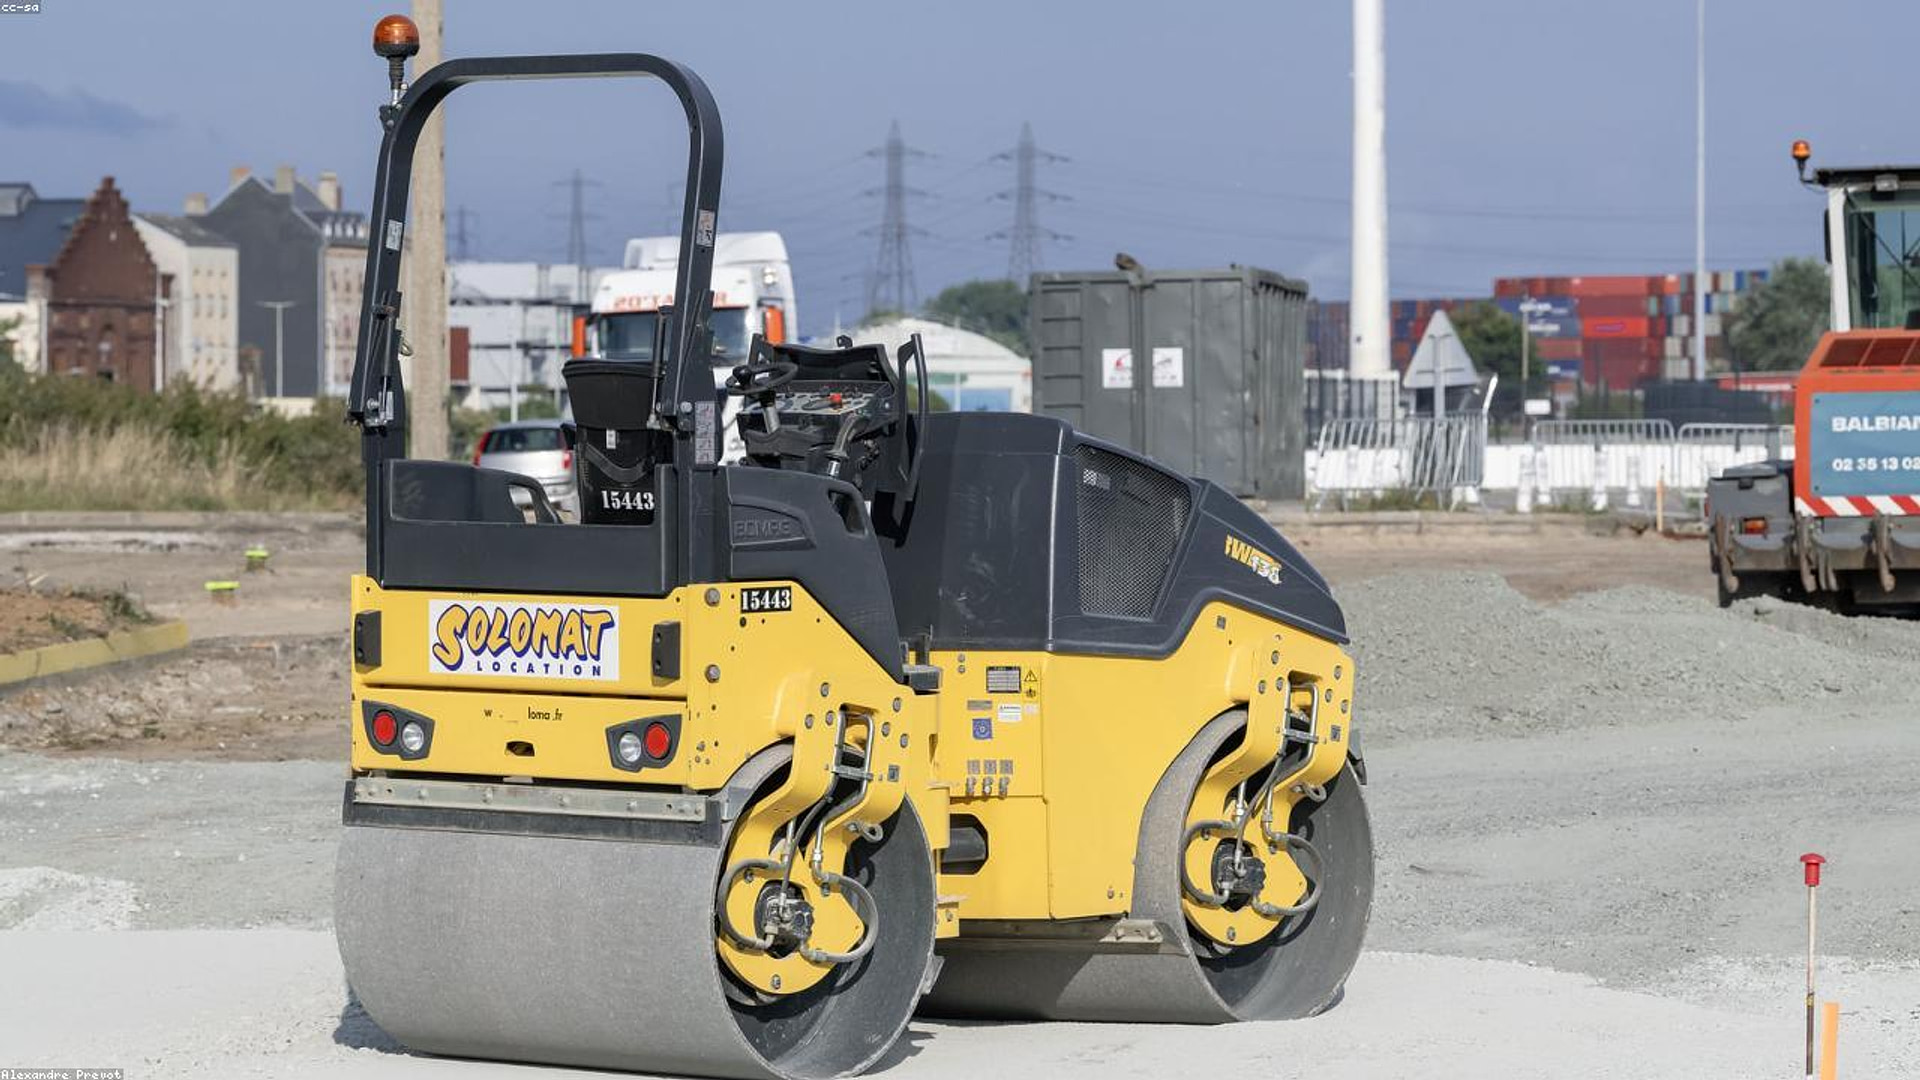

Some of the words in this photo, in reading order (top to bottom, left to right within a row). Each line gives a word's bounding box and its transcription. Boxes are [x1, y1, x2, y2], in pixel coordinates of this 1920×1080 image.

[1832, 457, 1853, 471] 02
[1881, 456, 1899, 471] 13
[601, 490, 655, 510] 15443
[742, 589, 791, 610] 15443
[432, 604, 615, 671] SOLOMAT
[476, 660, 601, 676] LOCATION
